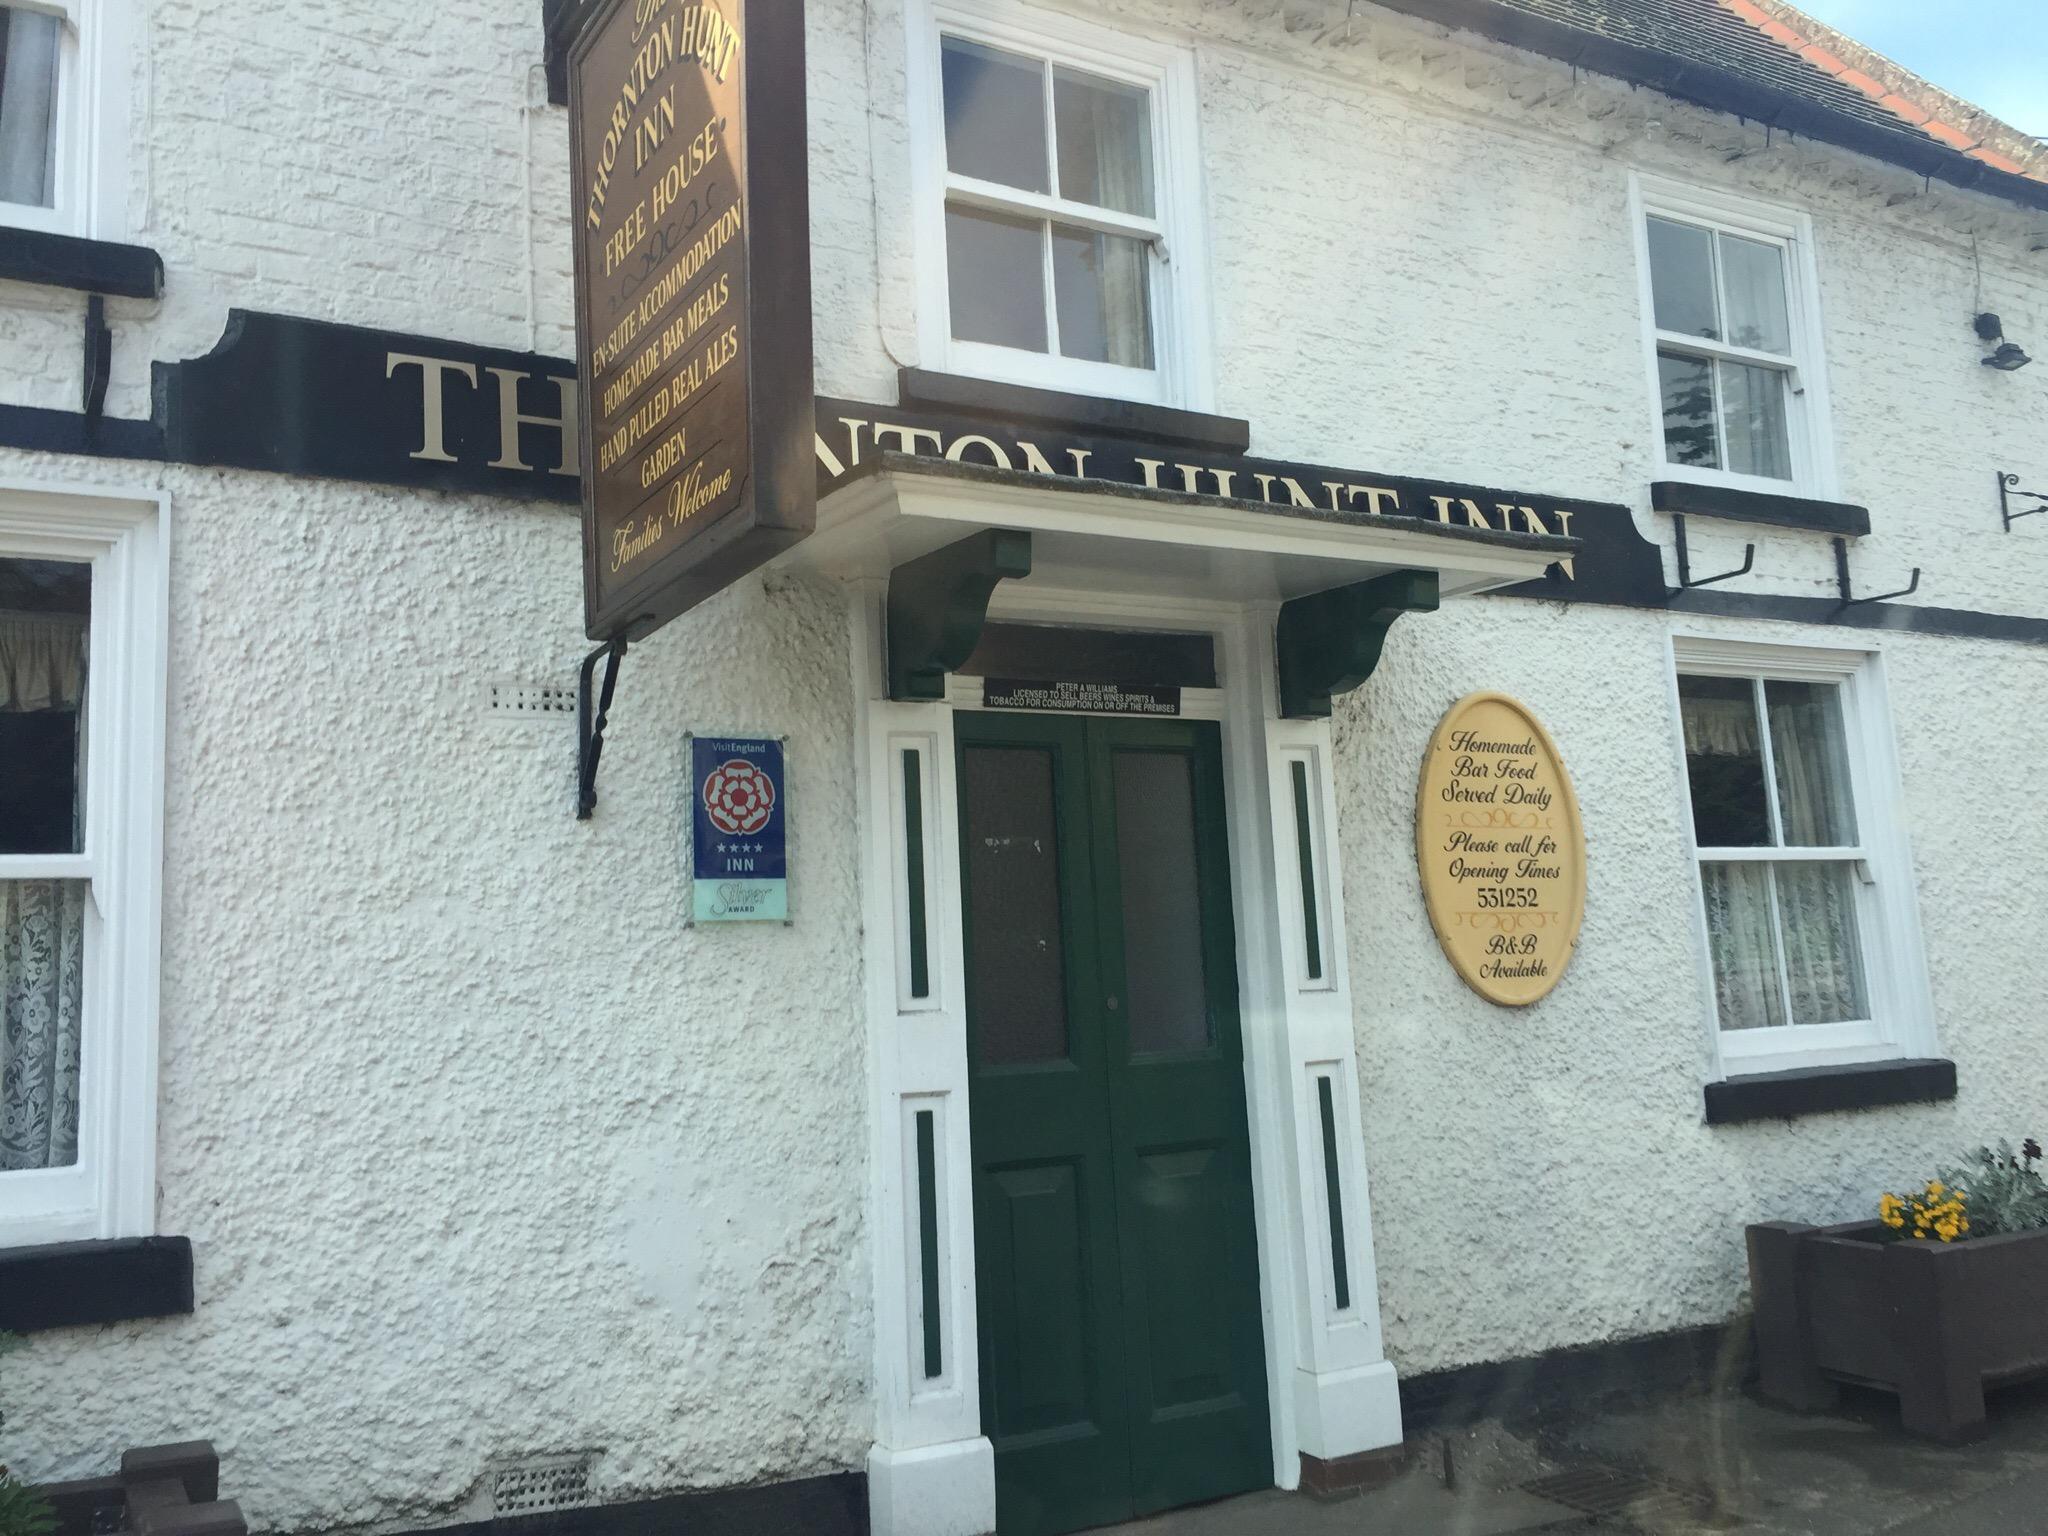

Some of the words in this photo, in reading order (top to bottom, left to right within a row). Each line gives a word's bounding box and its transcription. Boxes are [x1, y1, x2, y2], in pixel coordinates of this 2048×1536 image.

[587, 14, 675, 230] THORNTON
[680, 6, 741, 81] HUNT
[635, 84, 675, 172] INN
[605, 201, 647, 278] FREE
[652, 116, 719, 224] HOUSE
[593, 310, 637, 378] EN-SUITE
[638, 198, 741, 330] ACCOMMODATION
[604, 340, 660, 418] HOMEMADE
[662, 317, 685, 361] BAR
[687, 273, 729, 337] MEALS
[600, 430, 628, 472] HAND
[629, 388, 669, 447] PULLED
[672, 359, 702, 408] REAL
[705, 325, 738, 380] ALES
[386, 351, 580, 476] TH
[641, 428, 686, 488] GARDEN
[611, 514, 663, 573] Families
[667, 461, 732, 528] Welcome
[1013, 689, 1048, 699] LICENSED
[1050, 690, 1060, 699] TO
[1060, 691, 1077, 700] SELL
[1080, 691, 1102, 701] BEERS
[1103, 693, 1124, 702] WINES
[1056, 682, 1079, 692] PETER
[1086, 684, 1118, 694] WILLIAMS
[990, 696, 1025, 706] TOBACCO
[1026, 698, 1040, 707] FOR
[1041, 699, 1092, 709] CONSUMPTION
[1093, 700, 1103, 709] ON
[1104, 702, 1115, 710] OR
[1115, 702, 1128, 711] OFF
[1130, 703, 1142, 711] THE
[1143, 704, 1175, 713] PREMISES
[712, 742, 766, 753] VisitEngland
[1449, 730, 1537, 756] Homemade
[1450, 755, 1489, 778] Bar
[1494, 758, 1538, 780] Food
[1441, 779, 1498, 803] Served
[1503, 782, 1552, 811] Daily
[1443, 831, 1499, 853] Please
[1504, 835, 1533, 853] call
[1530, 835, 1557, 857] for
[726, 858, 754, 872] INN
[1449, 857, 1509, 884] Opening
[1515, 859, 1560, 879] Times
[728, 905, 755, 913] AWARD
[1477, 887, 1539, 908] 531252
[1484, 934, 1538, 955] B&B
[1479, 958, 1547, 979] Available
